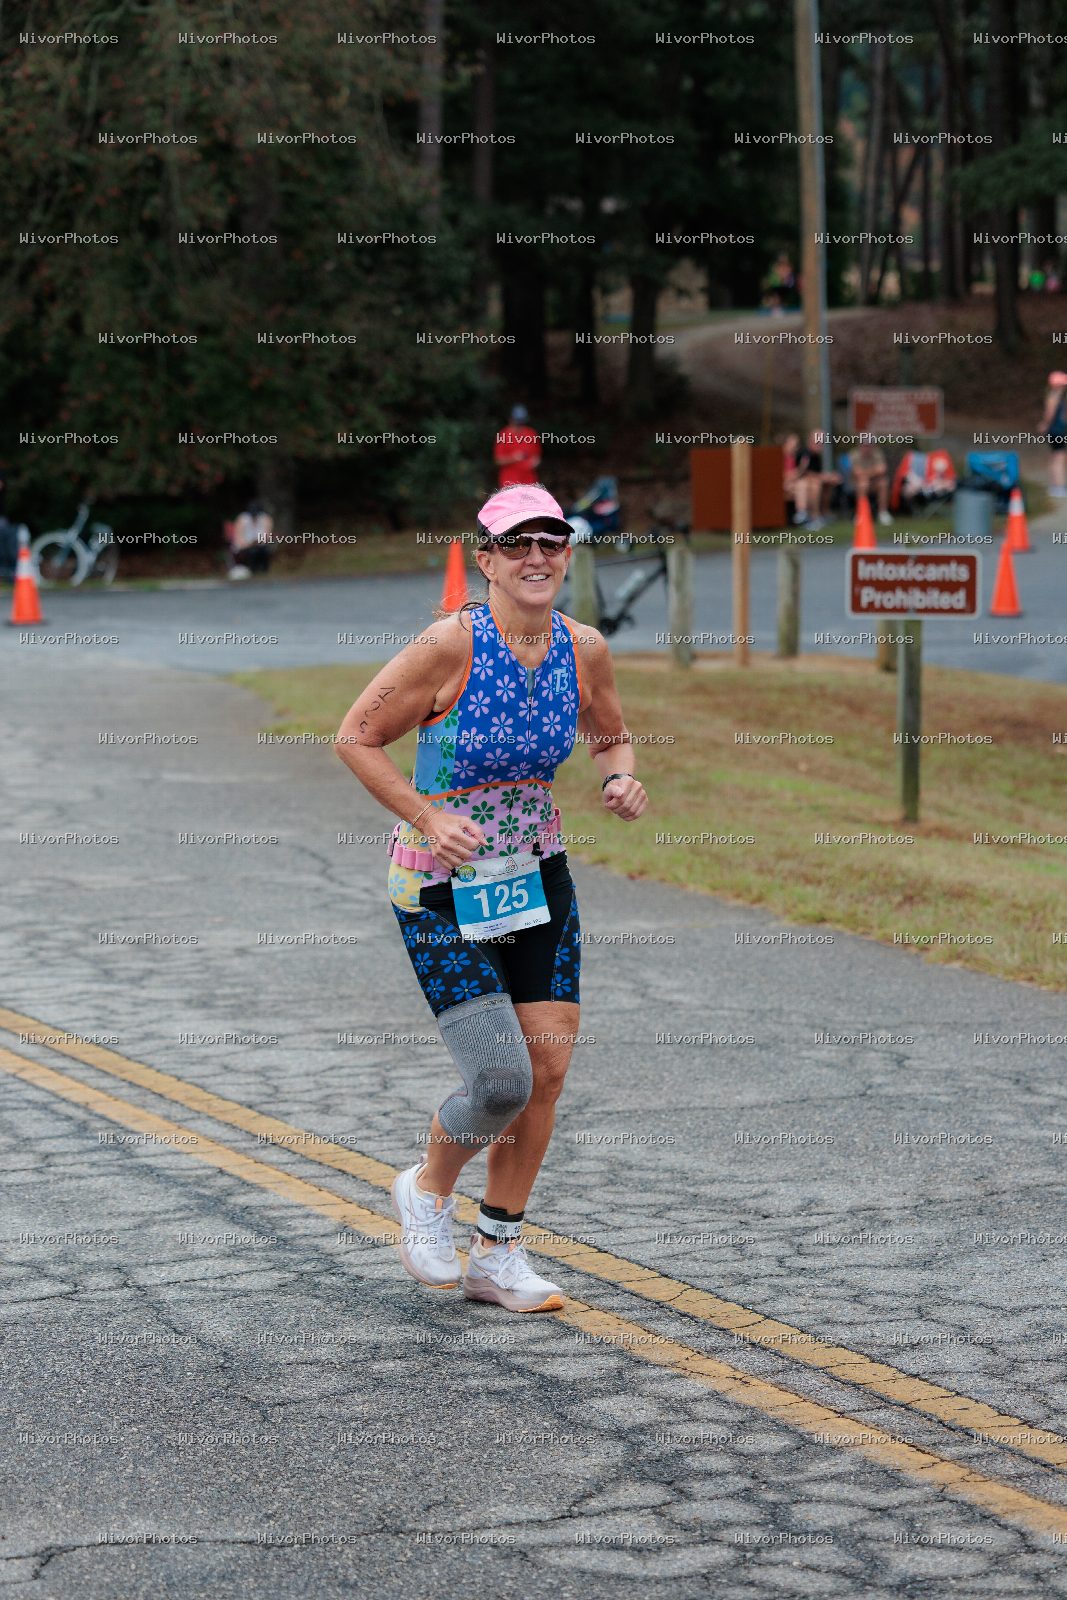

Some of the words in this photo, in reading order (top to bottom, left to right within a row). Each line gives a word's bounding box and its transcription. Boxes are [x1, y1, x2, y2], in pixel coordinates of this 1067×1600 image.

[857, 558, 971, 583] Intoxicants
[860, 586, 967, 610] Prohibited
[473, 878, 529, 918] 125
